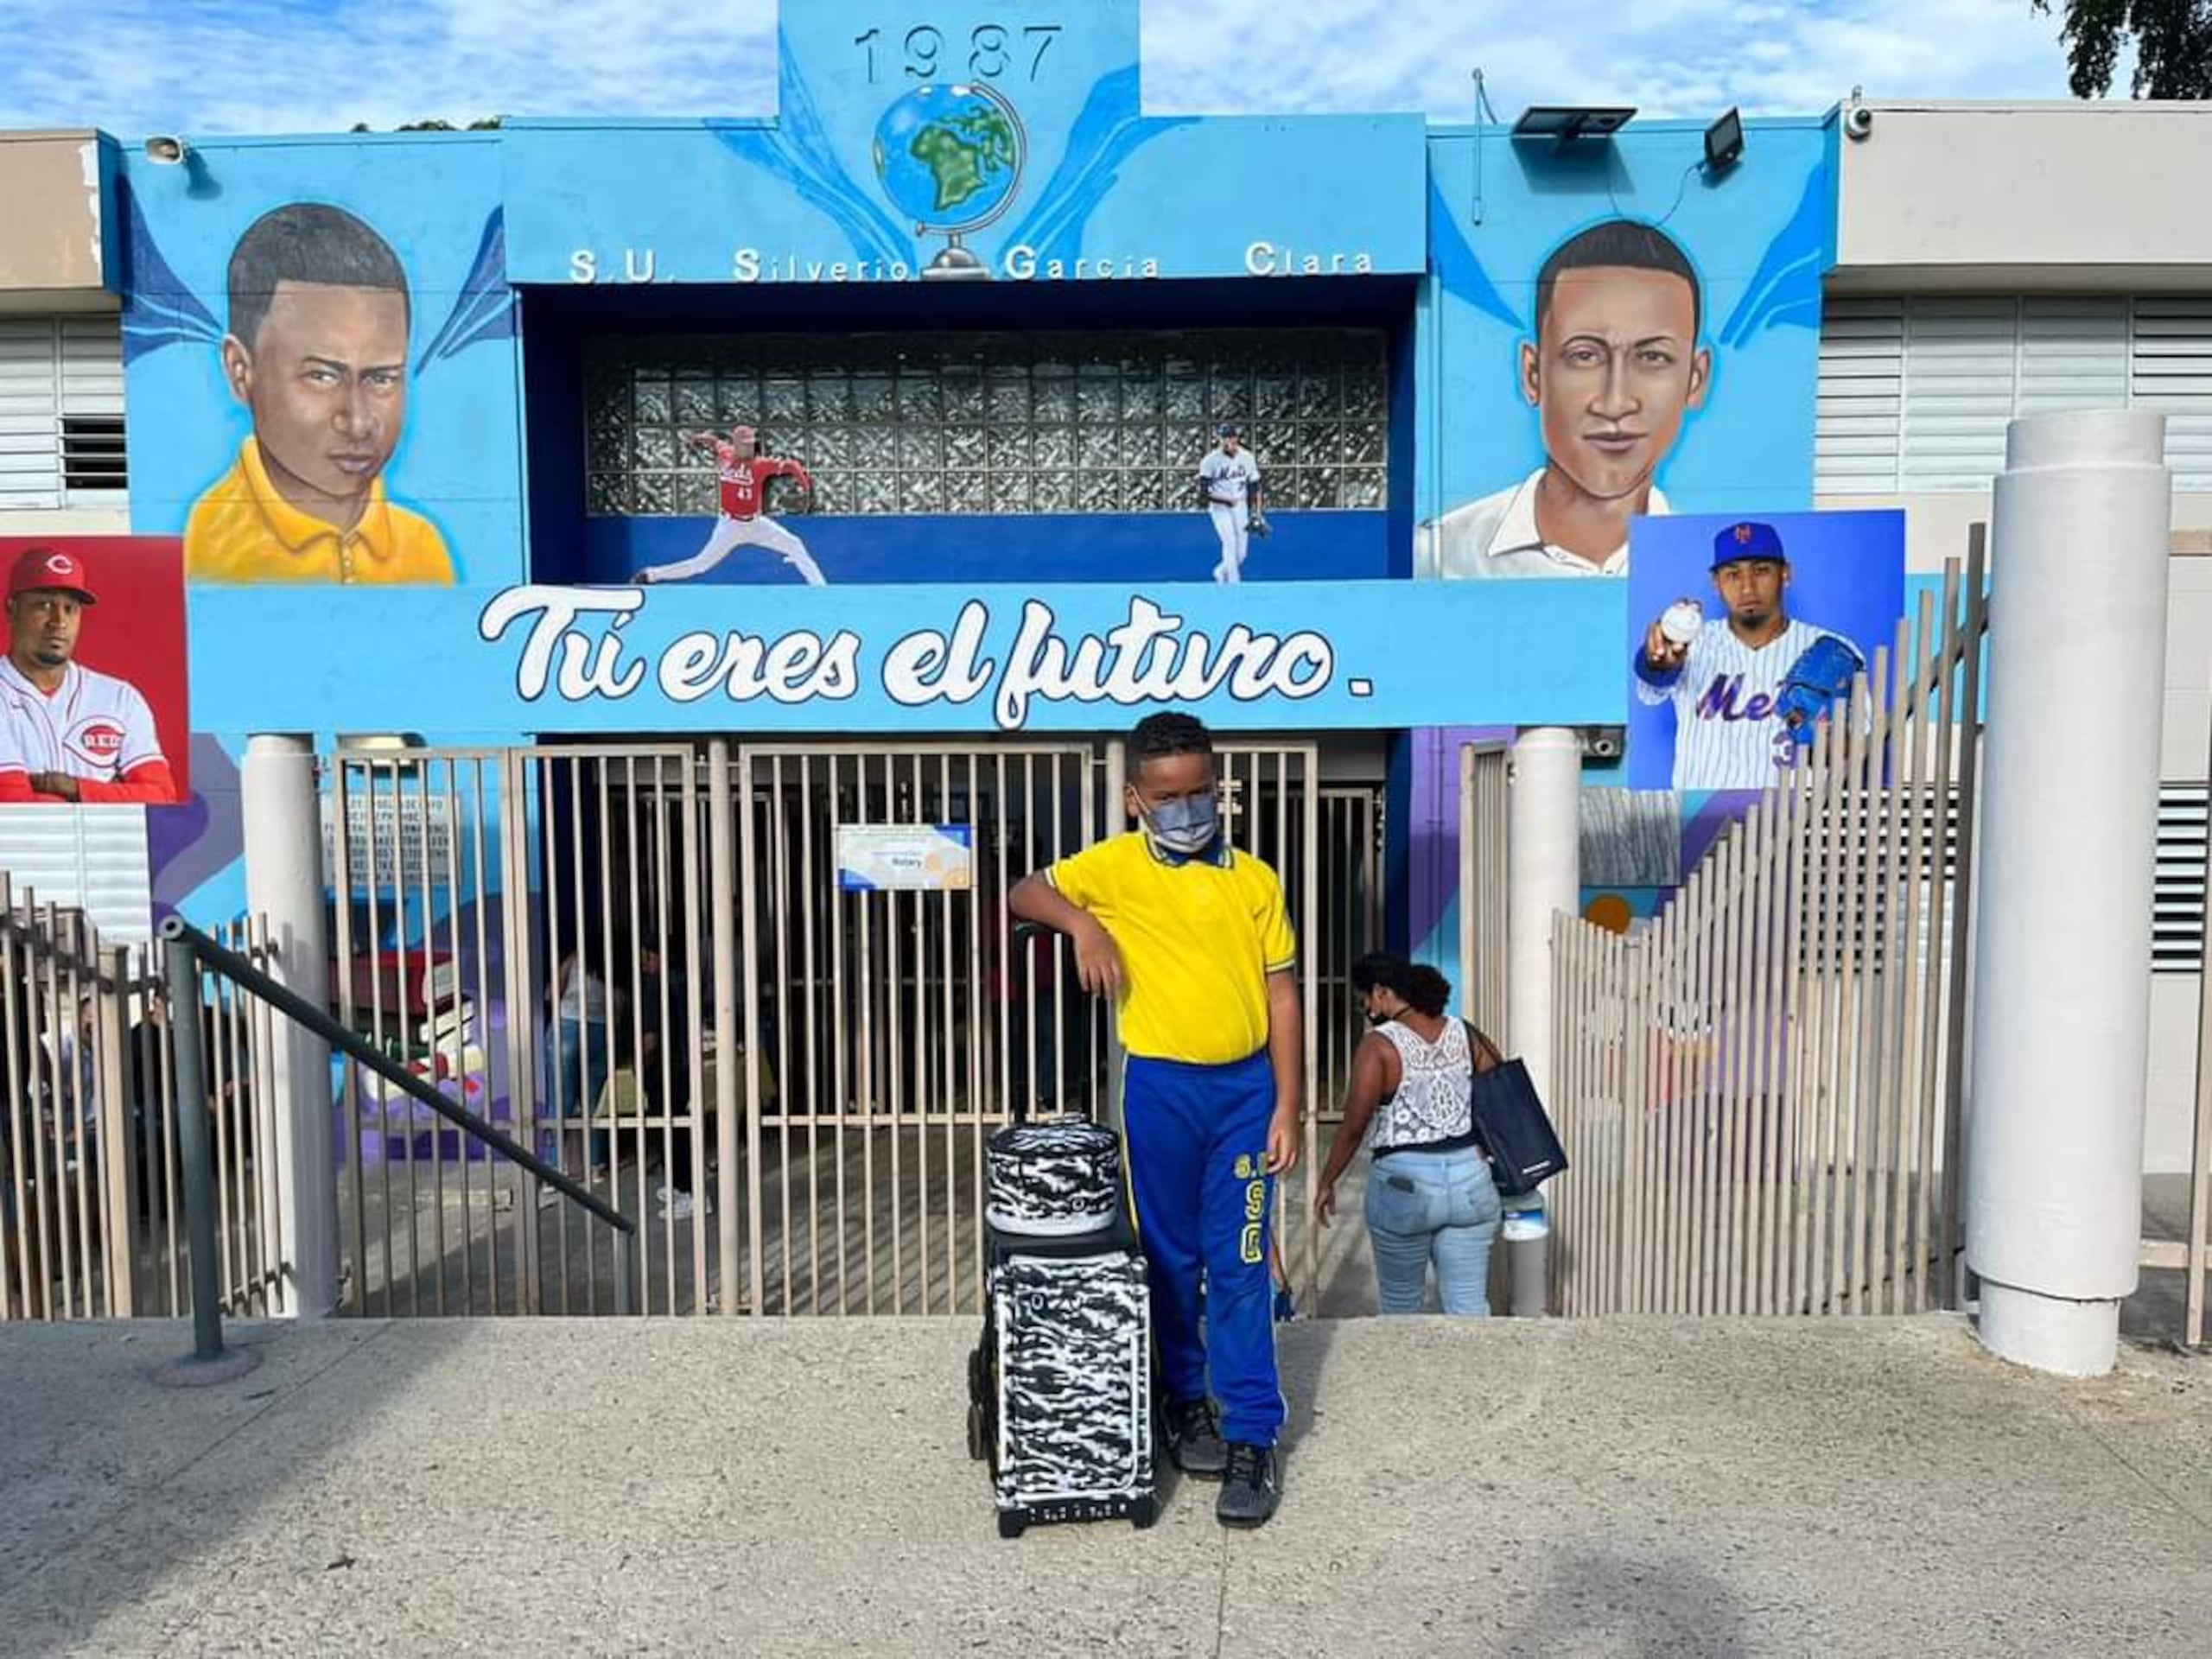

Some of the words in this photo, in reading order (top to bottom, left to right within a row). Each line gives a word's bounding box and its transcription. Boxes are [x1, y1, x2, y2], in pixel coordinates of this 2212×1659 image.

[854, 24, 1062, 83] 1987
[733, 248, 909, 283] Silverio
[1244, 241, 1372, 276] Clara
[479, 585, 646, 702] Tú
[658, 629, 860, 704] eres
[881, 599, 995, 706] el
[1695, 672, 1790, 722] Me
